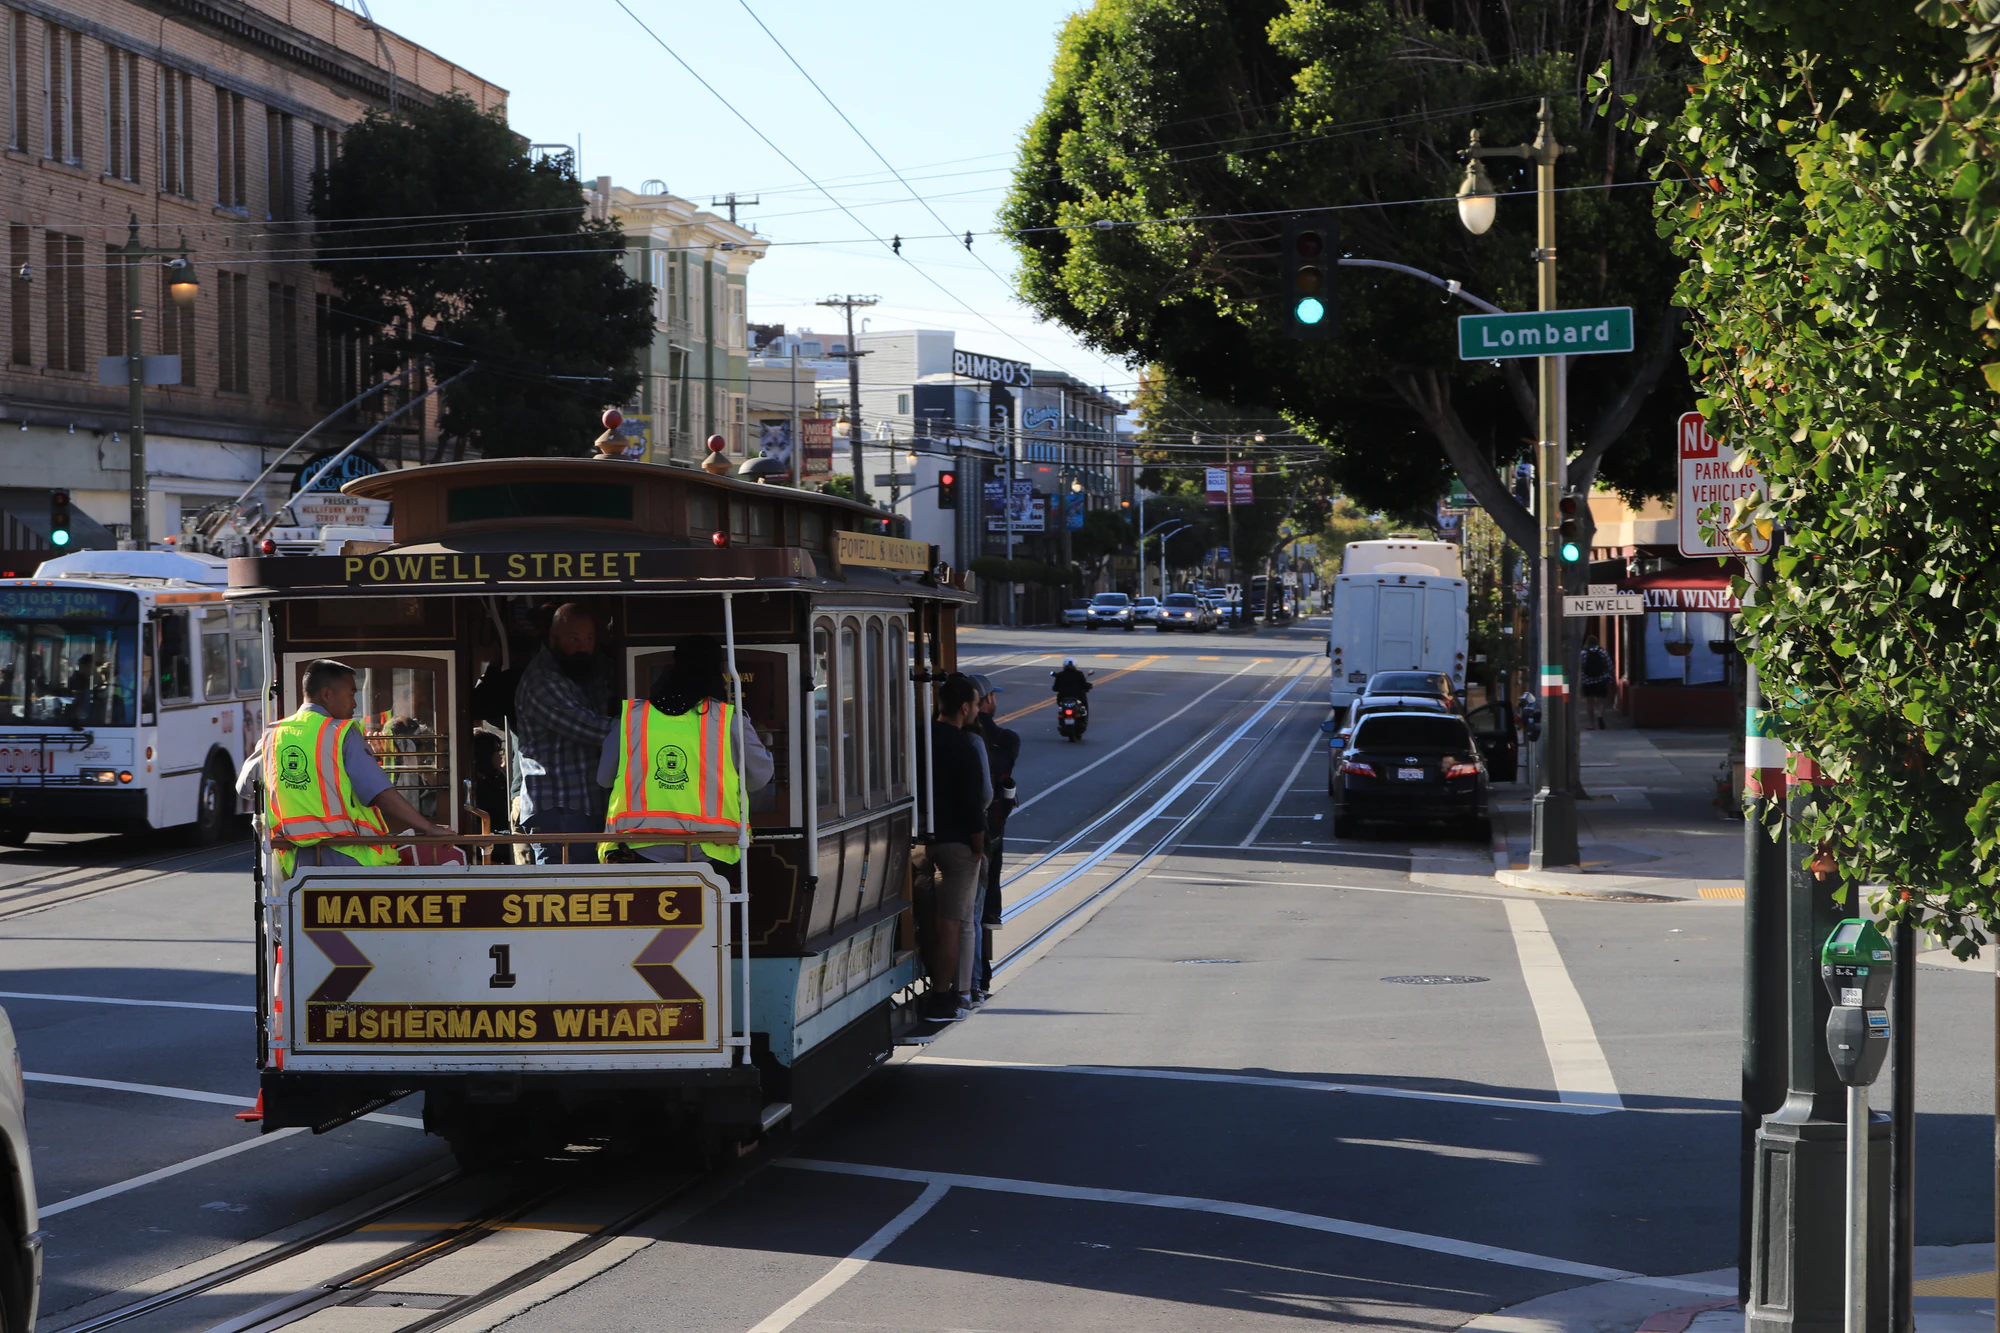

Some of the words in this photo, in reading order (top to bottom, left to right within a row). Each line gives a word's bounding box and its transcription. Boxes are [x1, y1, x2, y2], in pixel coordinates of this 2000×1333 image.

[1482, 320, 1609, 347] Lombard
[954, 351, 1031, 387] BIMBO'S
[804, 423, 831, 435] WOLF
[1684, 421, 1714, 452] NO
[840, 537, 876, 560] POWELL
[888, 543, 916, 564] MASON
[345, 555, 490, 581] POWELL
[507, 552, 641, 578] STREET
[7, 592, 98, 605] STOCKTON
[1574, 600, 1635, 611] NEWELL
[1643, 588, 1678, 607] ATM
[1682, 589, 1731, 608] WINE
[659, 781, 685, 791] OPERATIONS
[316, 894, 468, 924] MARKET
[501, 892, 635, 924] STREET
[488, 943, 517, 989] 1
[325, 1008, 538, 1039] FISHERMANS
[555, 1006, 682, 1038] WHARF
